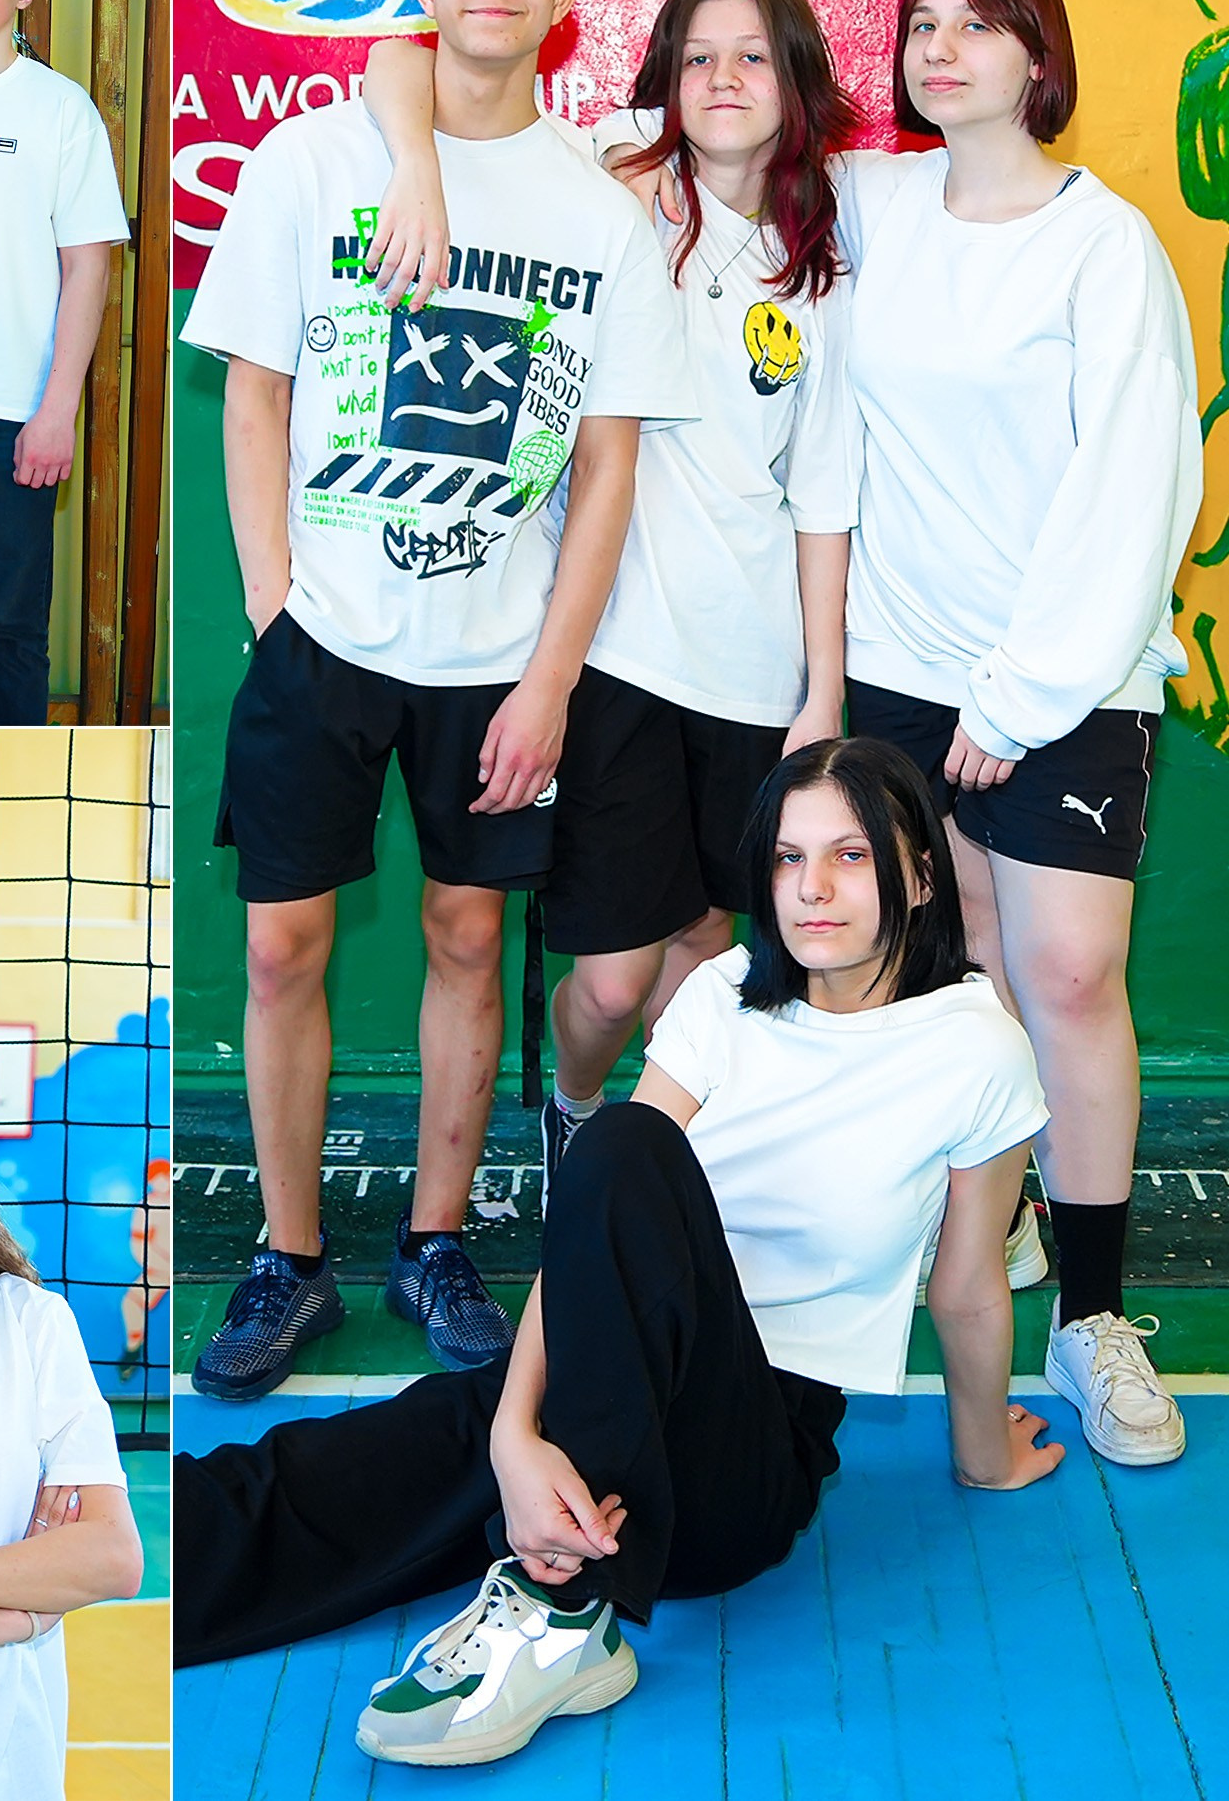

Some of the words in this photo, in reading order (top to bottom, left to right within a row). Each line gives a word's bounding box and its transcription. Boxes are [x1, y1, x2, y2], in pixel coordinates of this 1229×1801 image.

[537, 331, 593, 383] ONLY
[528, 357, 581, 410] GOOD
[311, 493, 329, 502] TEAM
[386, 502, 408, 514] PROVE
